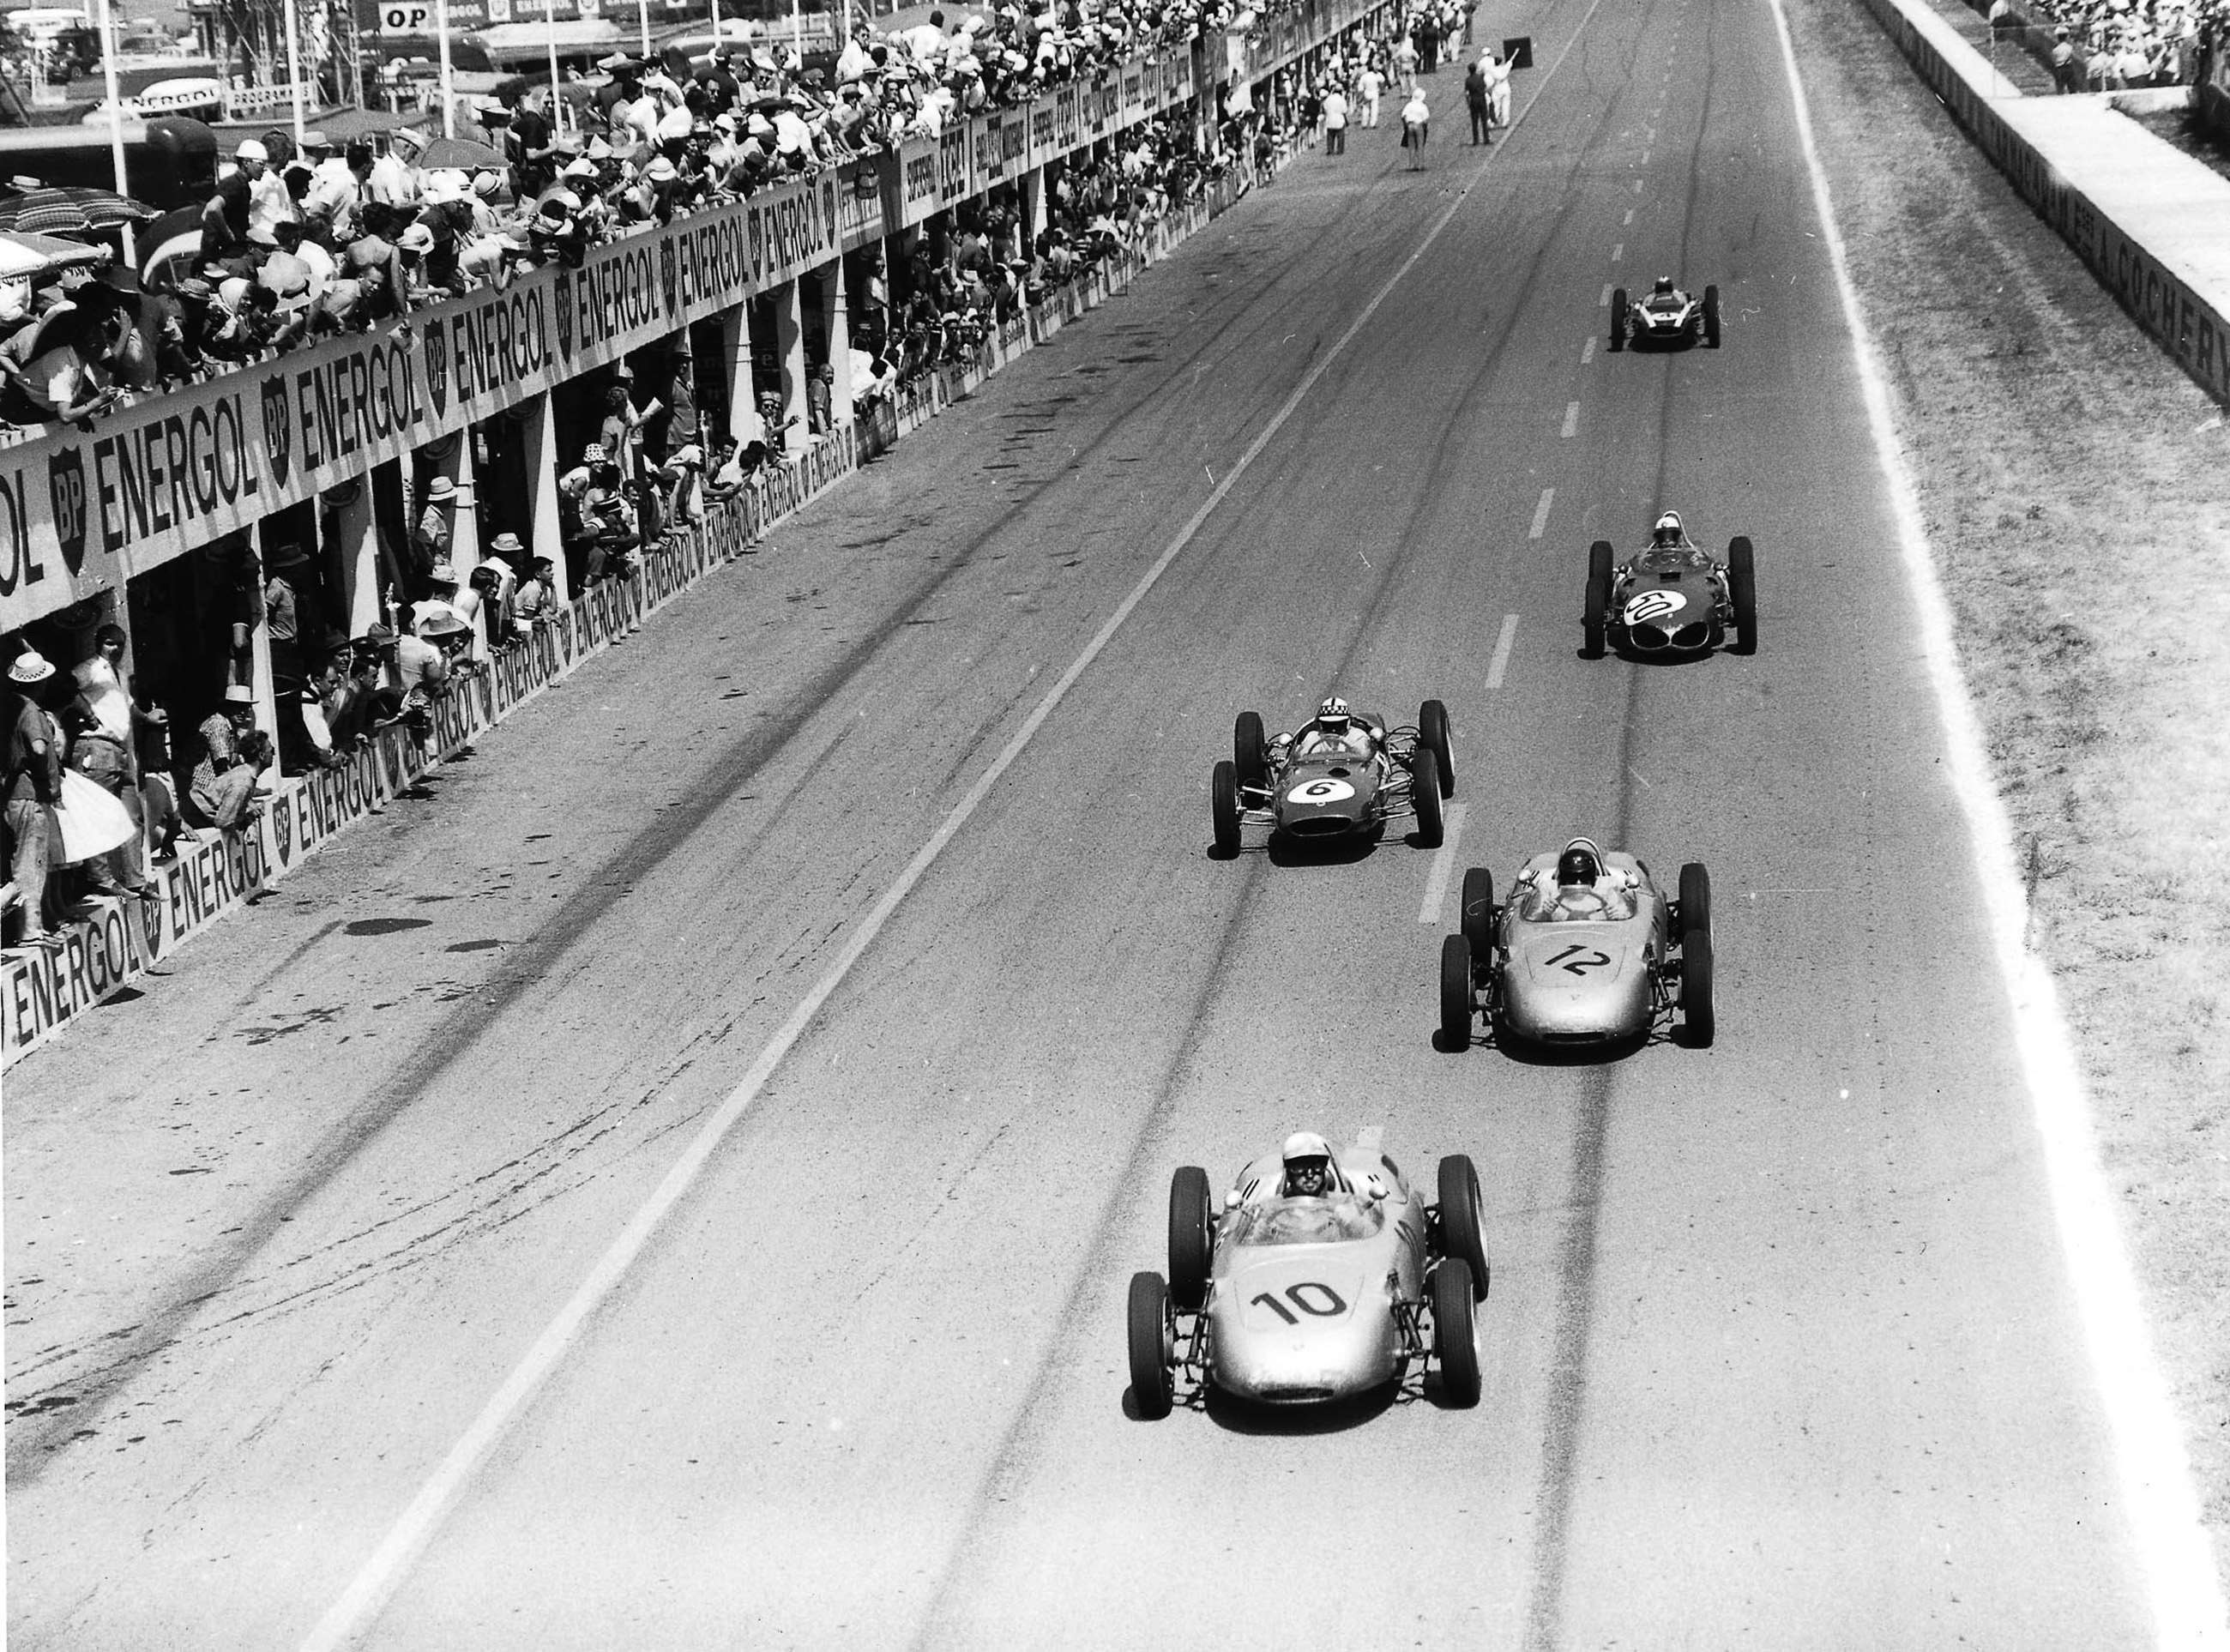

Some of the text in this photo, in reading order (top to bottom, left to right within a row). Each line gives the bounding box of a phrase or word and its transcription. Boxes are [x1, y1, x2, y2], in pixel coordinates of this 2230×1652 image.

[387, 9, 426, 27] OP
[54, 469, 83, 544] BP
[93, 392, 257, 554] ENERGOL
[264, 394, 286, 459] BP
[298, 348, 423, 473] ENERGOL
[429, 335, 444, 389] BP
[452, 285, 553, 404] ENERGOL
[578, 246, 660, 350] ENERGOL
[679, 215, 749, 308] ENERGOL
[764, 188, 823, 274] ENERGOL
[13, 901, 140, 1047] ENERGOL
[144, 900, 160, 941] BP
[168, 817, 272, 942] ENERGOL
[274, 807, 289, 847] BP
[297, 743, 383, 851] ENERGOL
[493, 623, 559, 714] ENERGOL
[575, 579, 632, 657] ENERGOL
[644, 534, 696, 610] ENERGOL
[1305, 781, 1336, 796] 6
[1545, 944, 1611, 976] 12
[1251, 1282, 1347, 1326] 10
